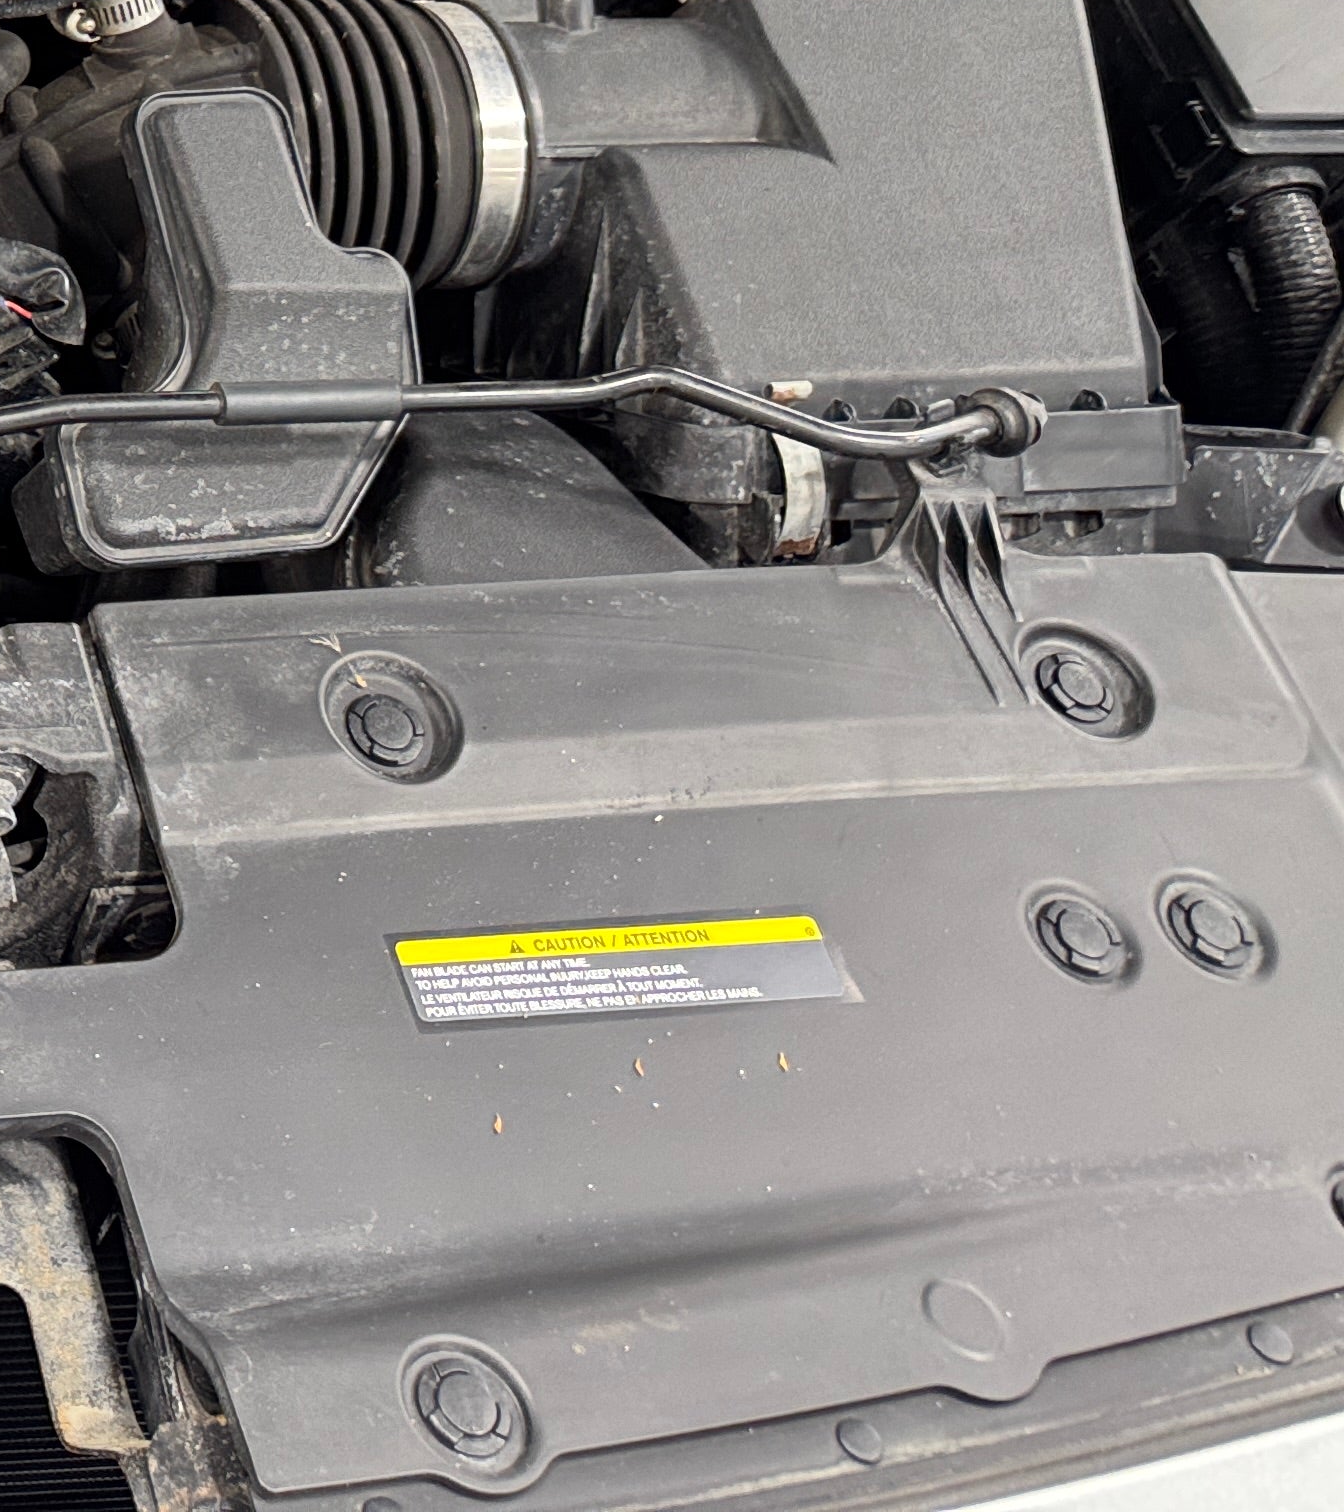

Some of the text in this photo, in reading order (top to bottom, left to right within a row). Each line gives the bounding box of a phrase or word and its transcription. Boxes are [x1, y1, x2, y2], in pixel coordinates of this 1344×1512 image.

[533, 929, 711, 952] CAUTION / ATTENTION
[411, 967, 433, 978] FAN
[433, 965, 469, 976] BLADE
[469, 963, 492, 974] CAN
[493, 960, 525, 972] START
[527, 959, 539, 971] AT
[541, 958, 562, 970] ANY
[415, 979, 432, 991] TO
[433, 977, 460, 989] HELP
[462, 975, 493, 987] AVOID
[494, 972, 550, 986] PERSONAL
[612, 966, 650, 978] HANDS
[421, 993, 435, 1005] LE
[436, 990, 502, 1005] VENTILATEUR
[503, 987, 544, 1000] RISQUE
[543, 985, 559, 996] DE
[559, 982, 617, 996] DÉMARRER
[626, 980, 653, 992] TOUT
[426, 1005, 457, 1017] POUR
[493, 1002, 528, 1014] TOUTE
[586, 996, 603, 1007] NE
[602, 995, 624, 1007] PAS
[641, 990, 706, 1005] APPROCHER
[705, 989, 727, 1000] LES
